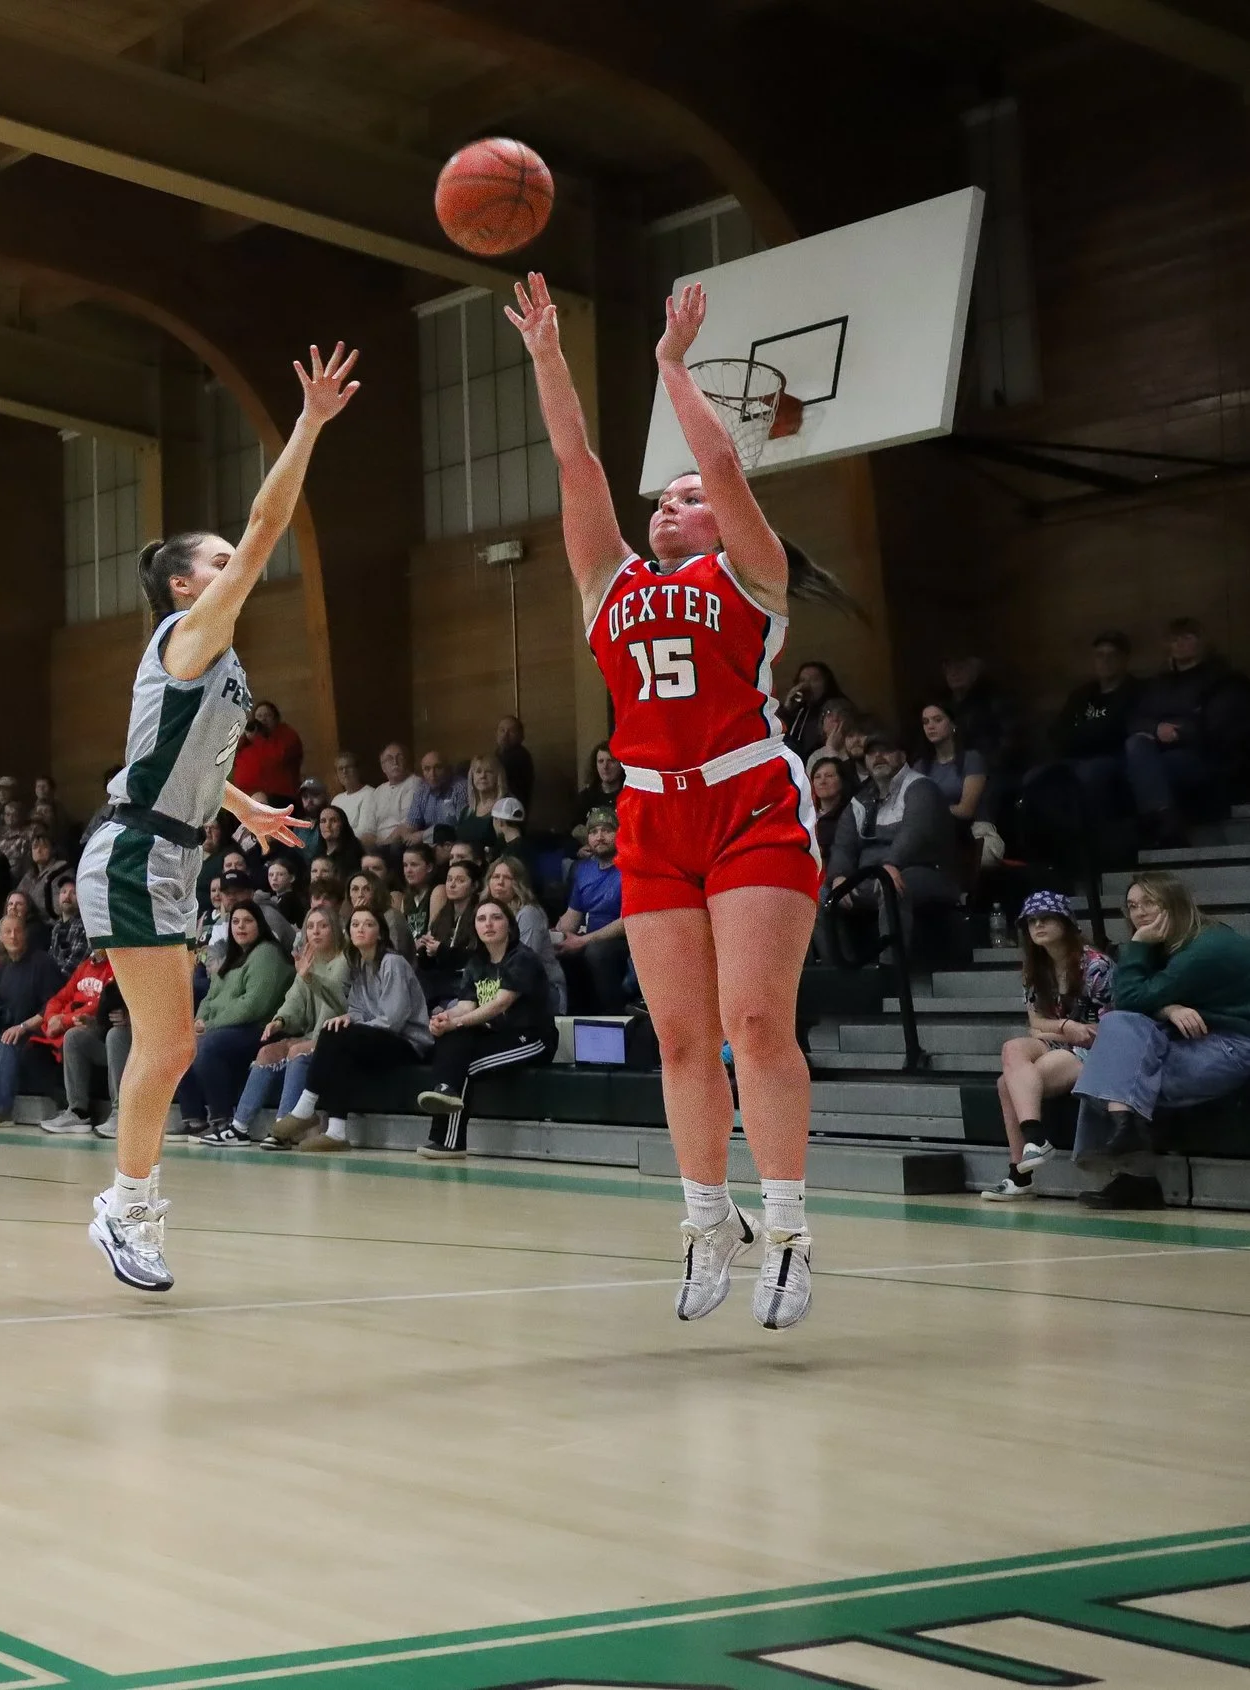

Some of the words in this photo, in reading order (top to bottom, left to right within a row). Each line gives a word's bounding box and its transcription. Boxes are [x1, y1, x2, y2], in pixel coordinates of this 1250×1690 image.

[607, 584, 722, 643] DEXTER
[628, 637, 698, 702] 15
[675, 775, 687, 790] D
